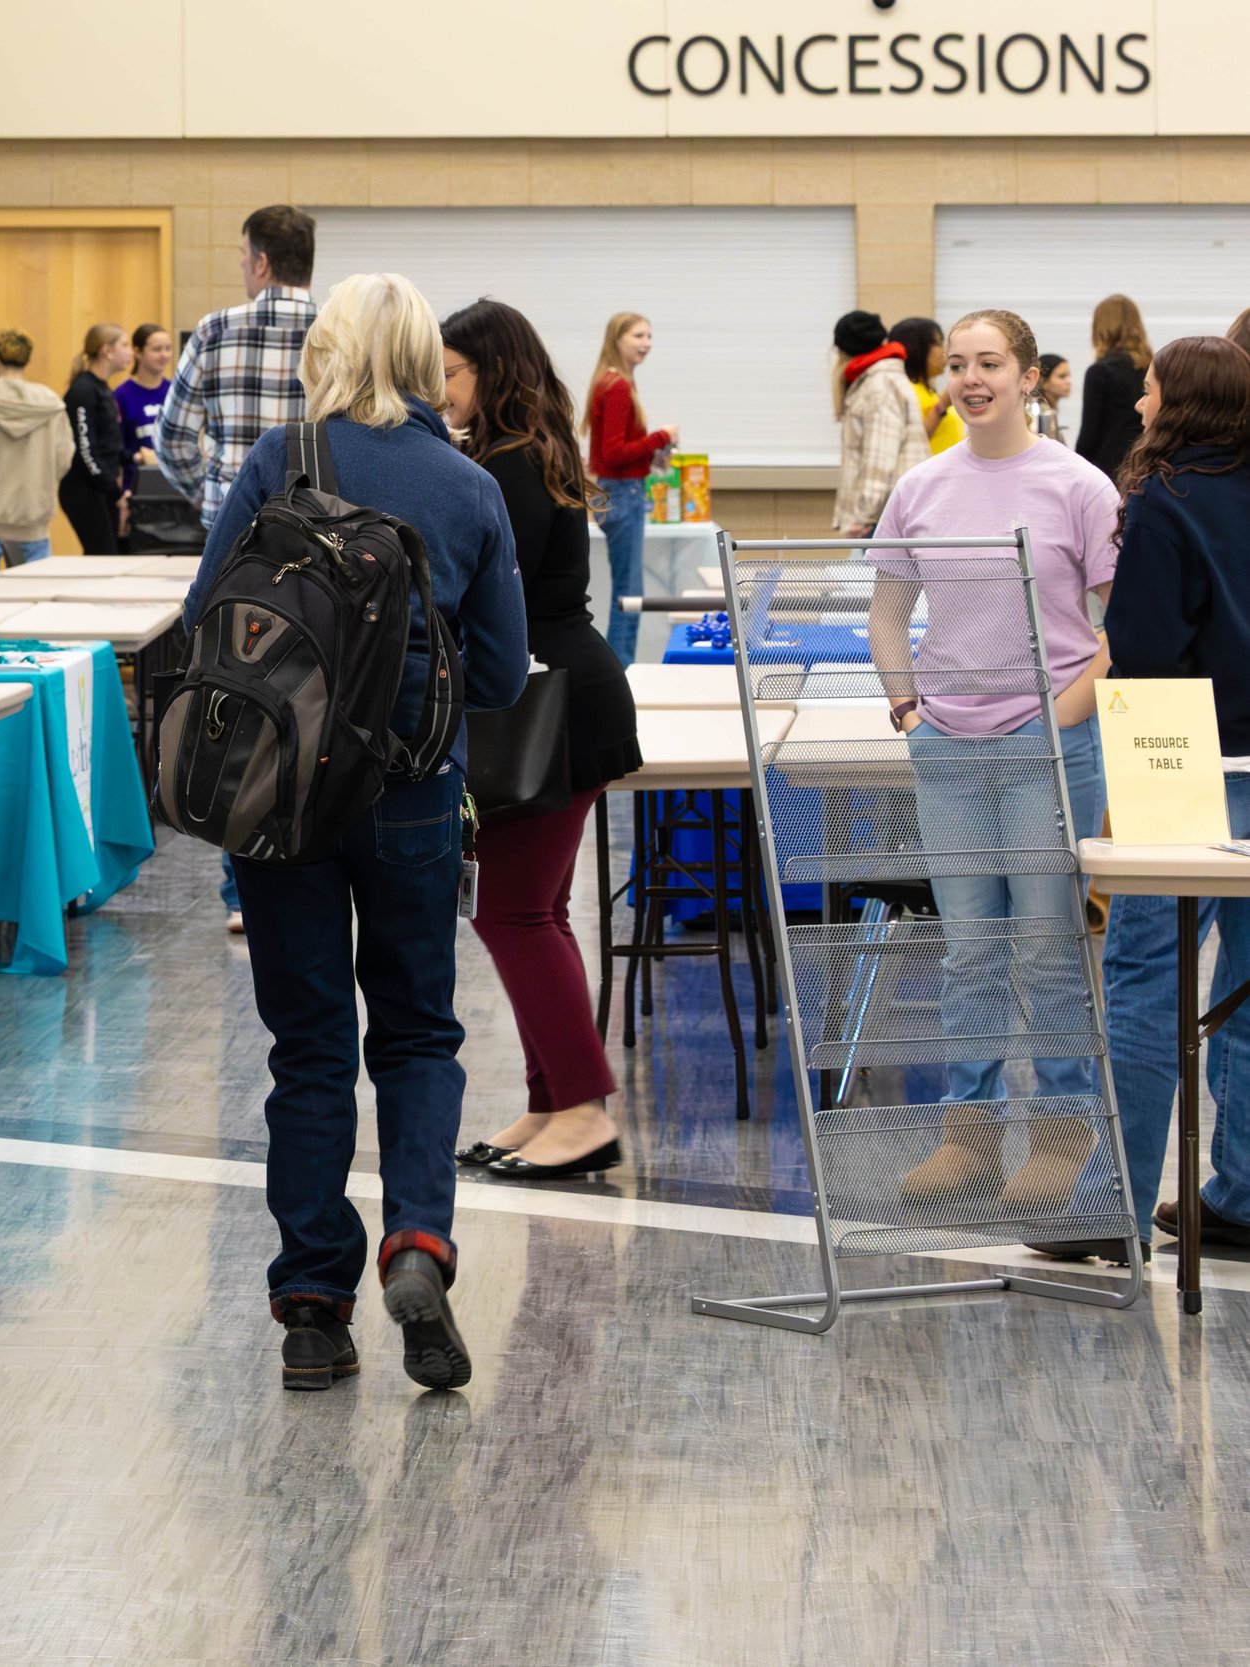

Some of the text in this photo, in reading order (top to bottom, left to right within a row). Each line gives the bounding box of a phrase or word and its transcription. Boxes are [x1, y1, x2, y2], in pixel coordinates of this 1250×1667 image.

[627, 32, 1151, 97] CONCESSIONS
[1133, 737, 1190, 749] RESOURCE
[1148, 758, 1184, 770] TABLE
